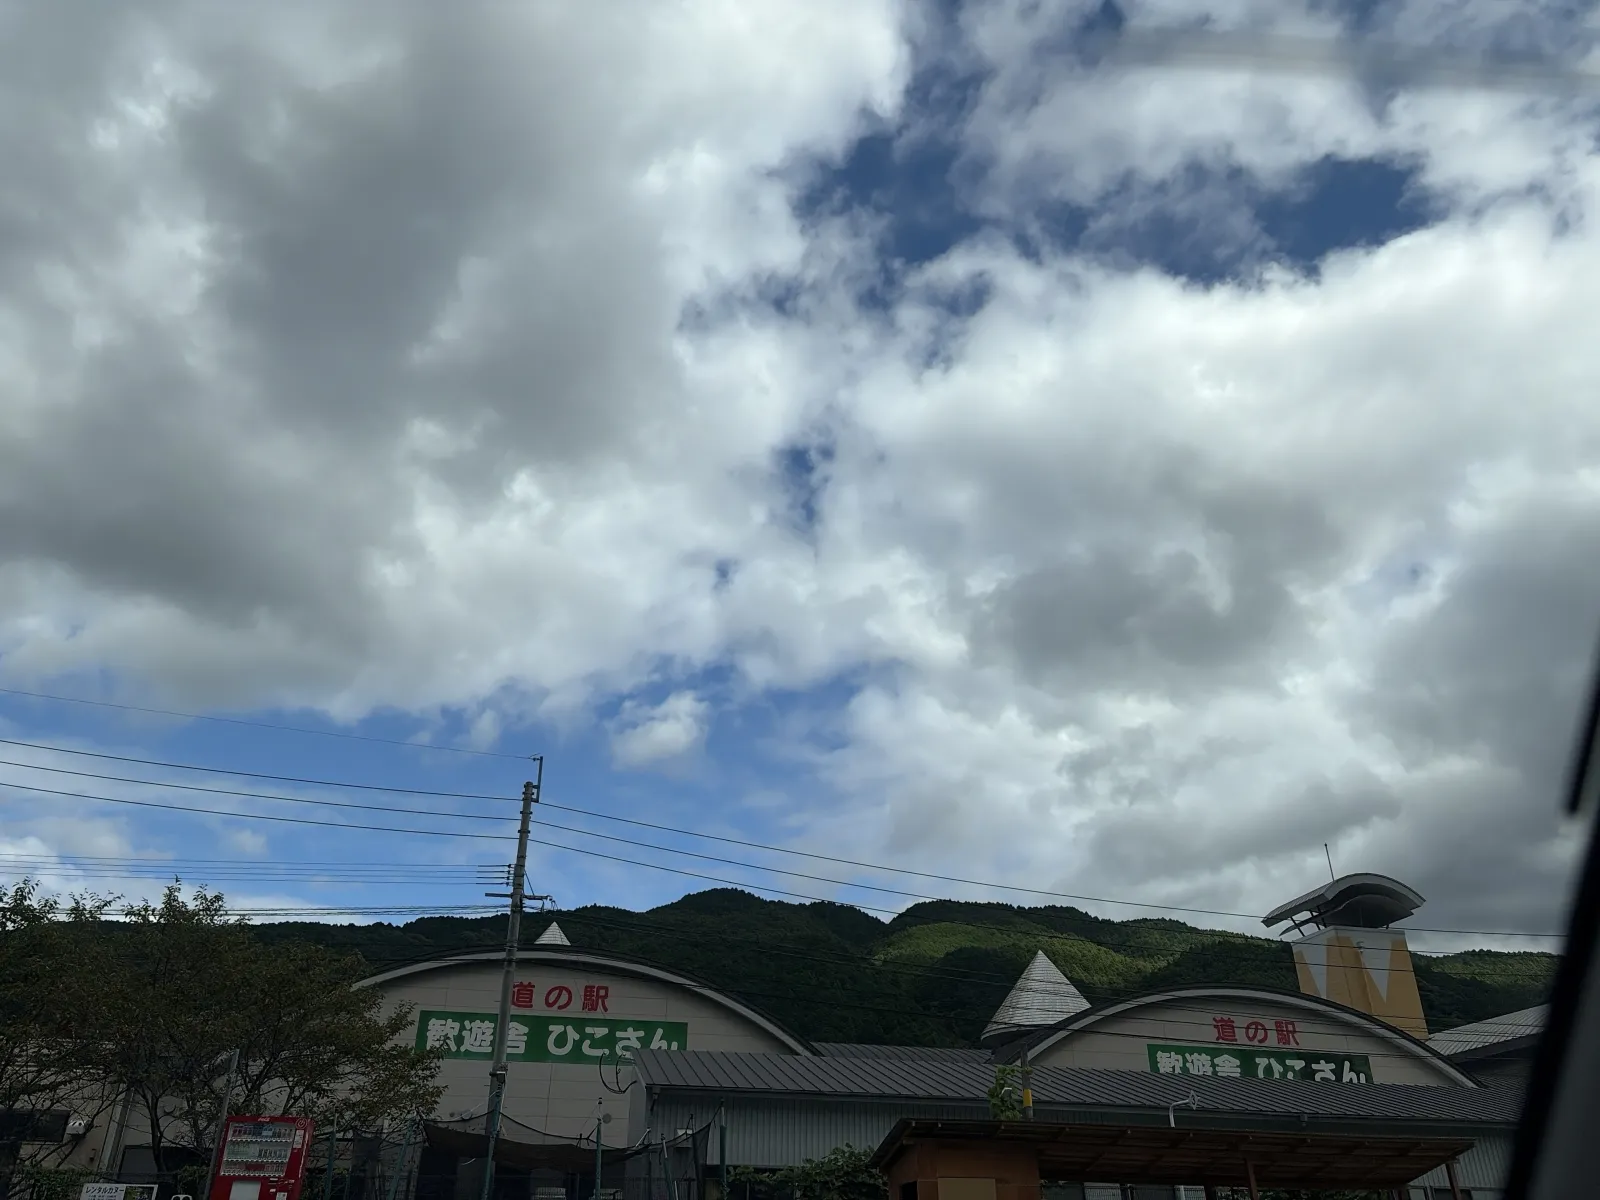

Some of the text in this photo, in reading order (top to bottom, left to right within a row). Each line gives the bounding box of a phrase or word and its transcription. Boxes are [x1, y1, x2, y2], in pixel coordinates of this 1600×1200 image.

[511, 982, 609, 1012] 道の駅
[547, 1024, 678, 1056] ひこさん
[1213, 1017, 1300, 1046] 道の駅
[1156, 1051, 1242, 1077] 歓遊舎
[85, 1186, 125, 1194] レンタルカヌー
